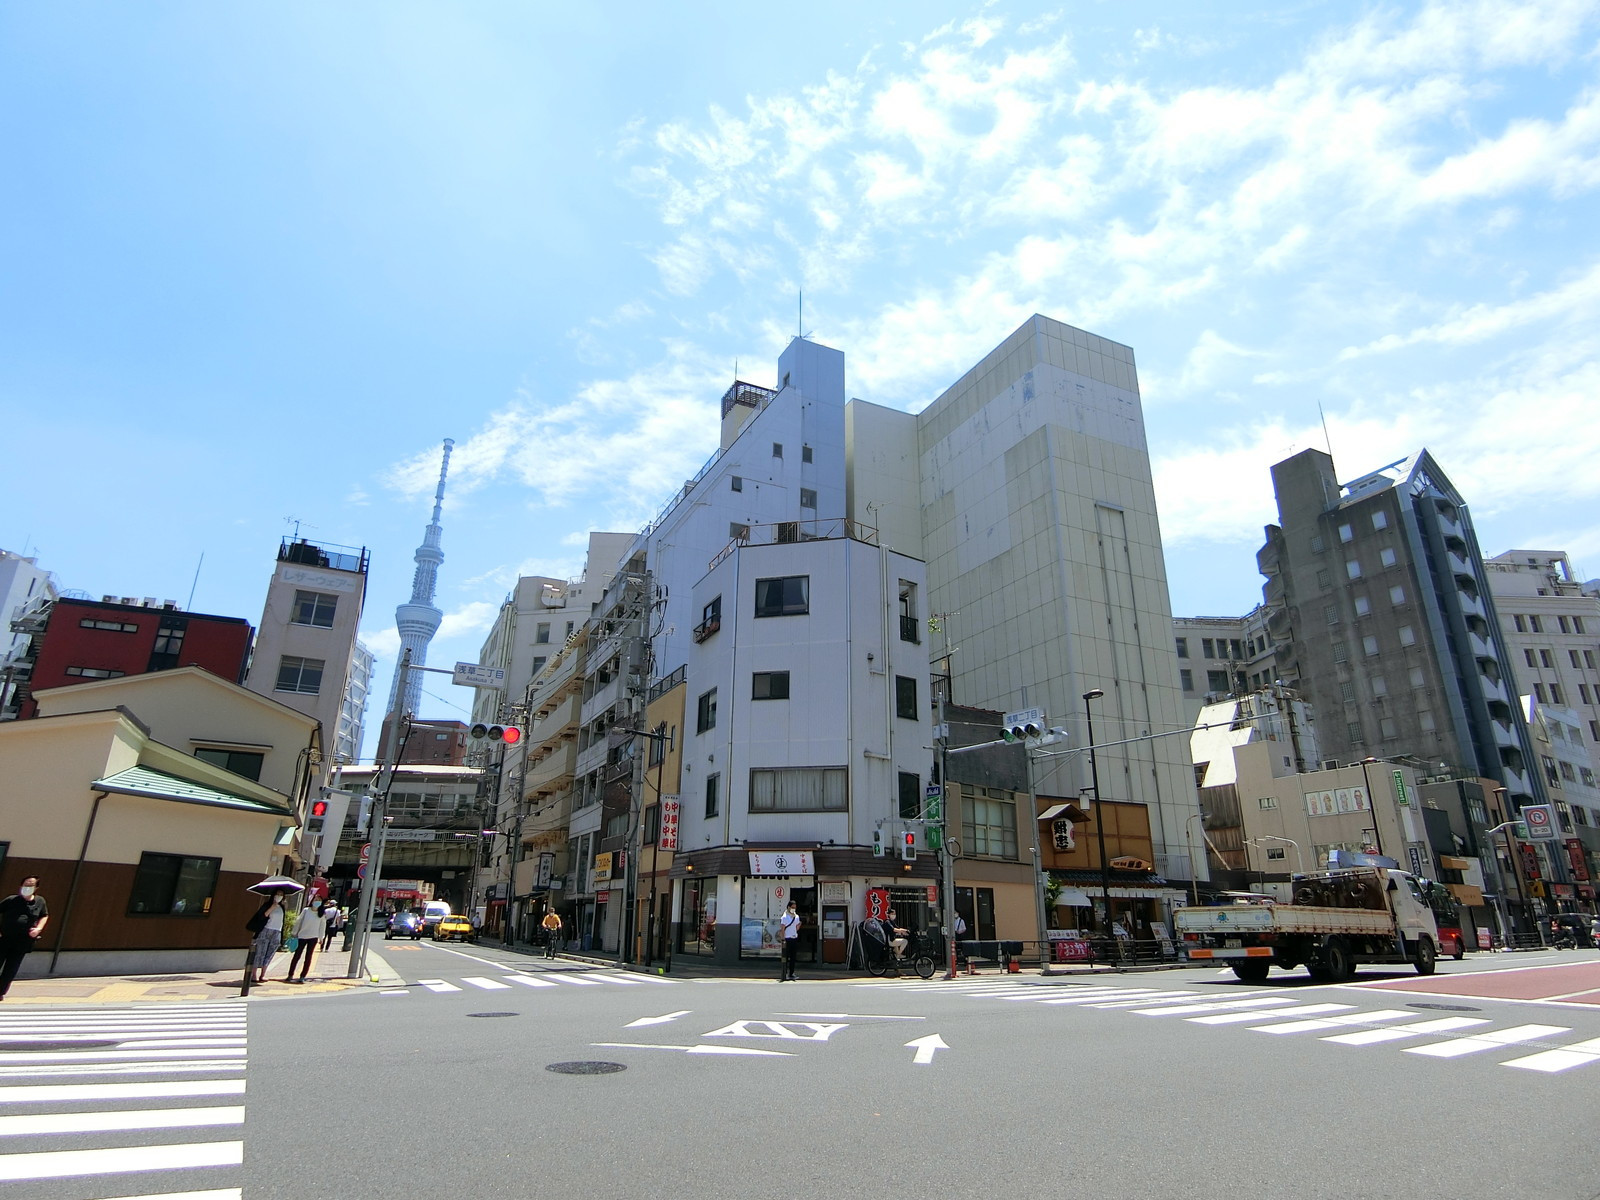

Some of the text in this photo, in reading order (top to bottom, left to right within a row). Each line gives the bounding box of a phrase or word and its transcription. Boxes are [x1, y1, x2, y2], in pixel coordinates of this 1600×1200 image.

[457, 665, 505, 680] 浅草二丁目
[1006, 709, 1038, 725] 浅草二丁目
[661, 801, 671, 849] もり中華
[670, 801, 679, 849] 中華そば
